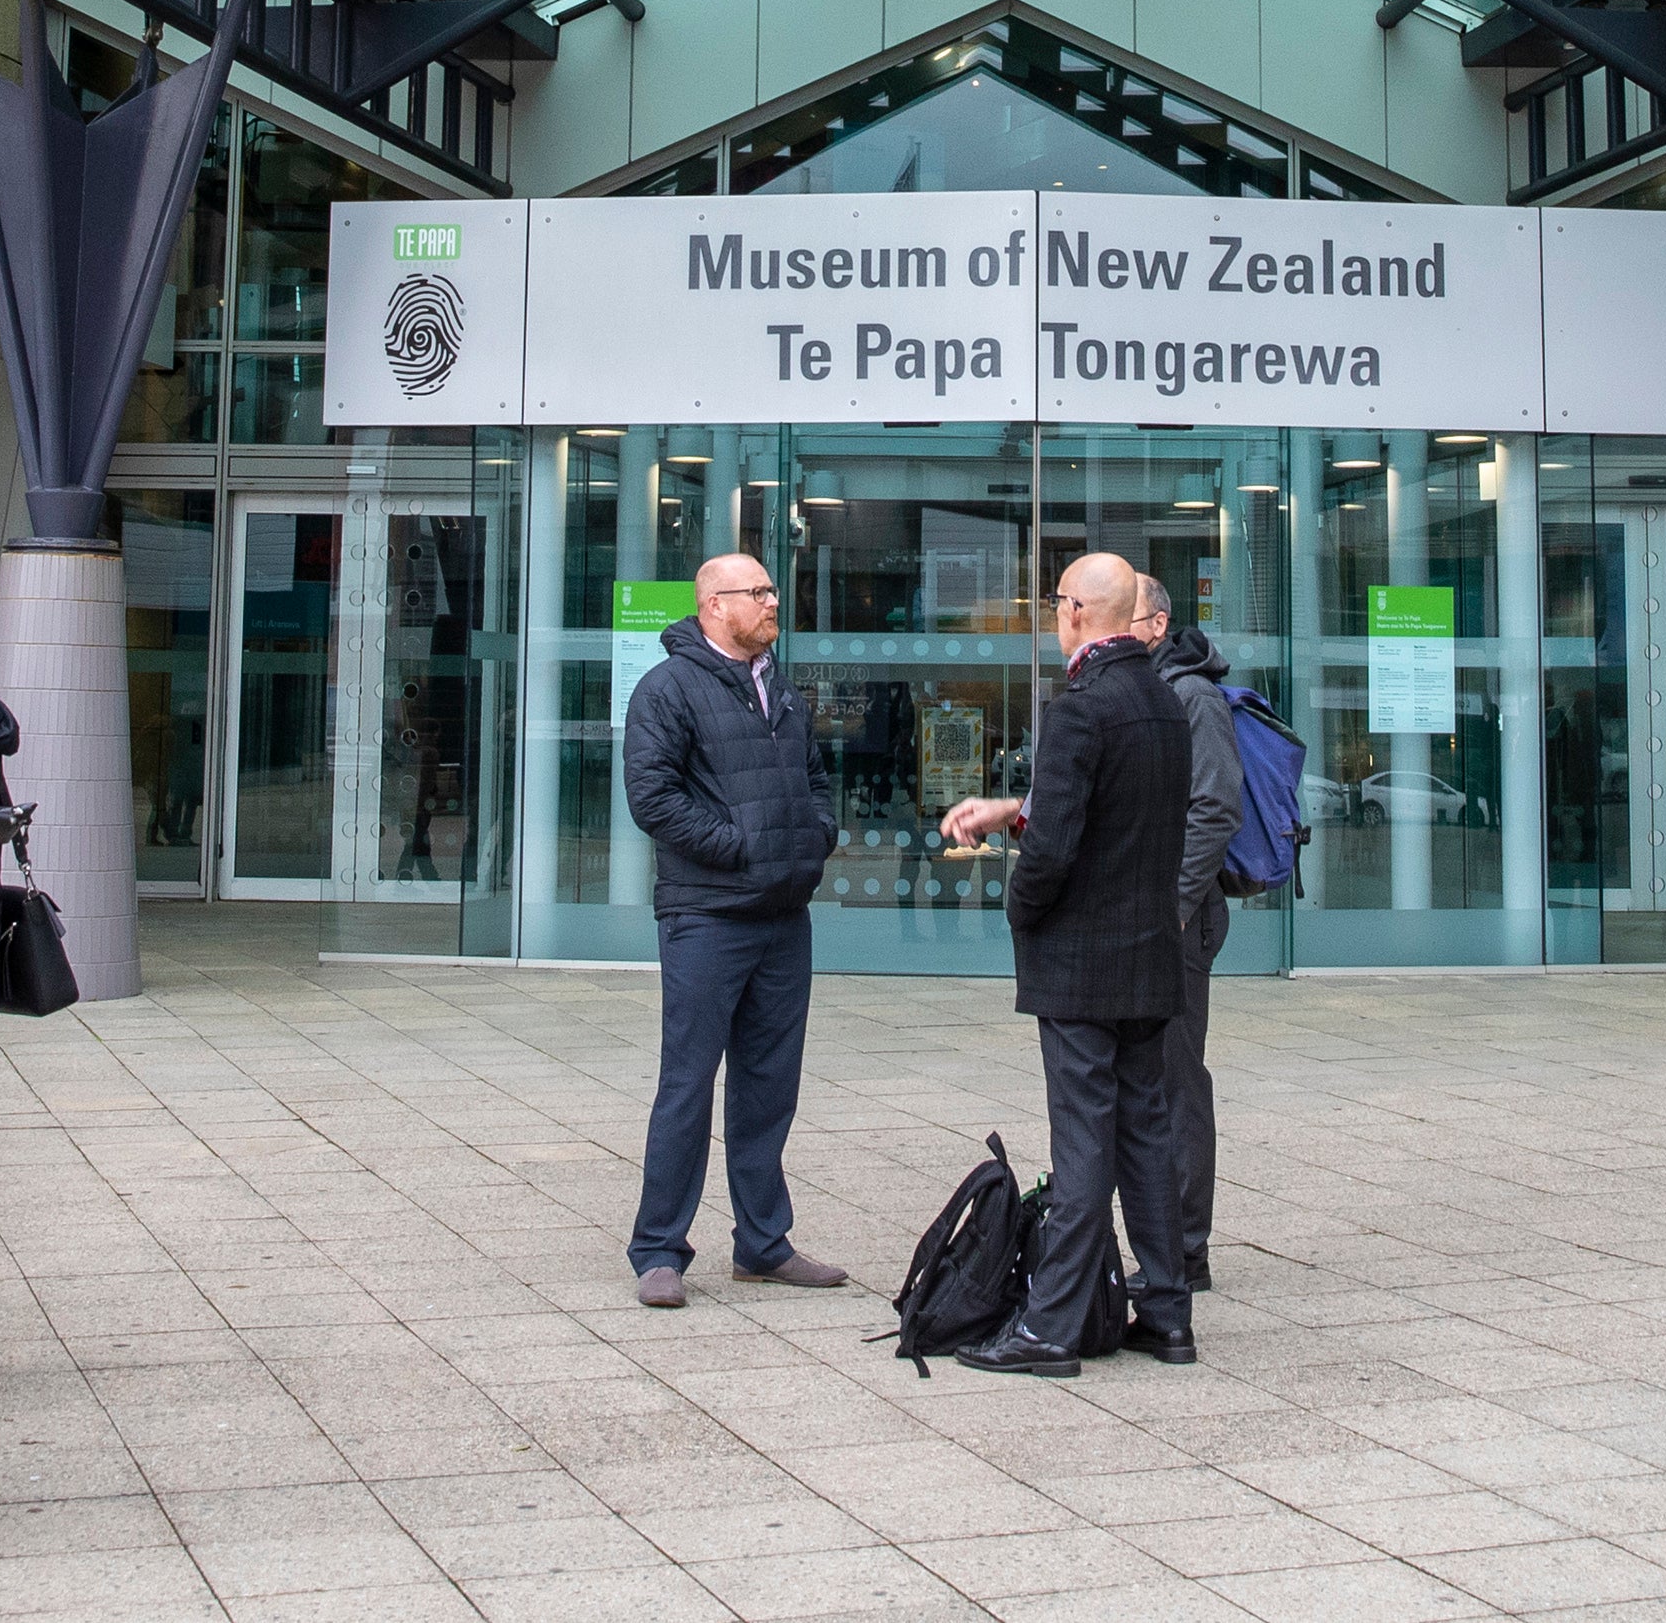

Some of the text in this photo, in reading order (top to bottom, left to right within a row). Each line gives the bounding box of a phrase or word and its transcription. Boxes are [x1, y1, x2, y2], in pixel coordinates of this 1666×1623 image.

[396, 227, 457, 257] TE PAPA
[687, 229, 1447, 299] Museum of New Zealand
[767, 321, 1382, 397] Te Papa Tongarewa
